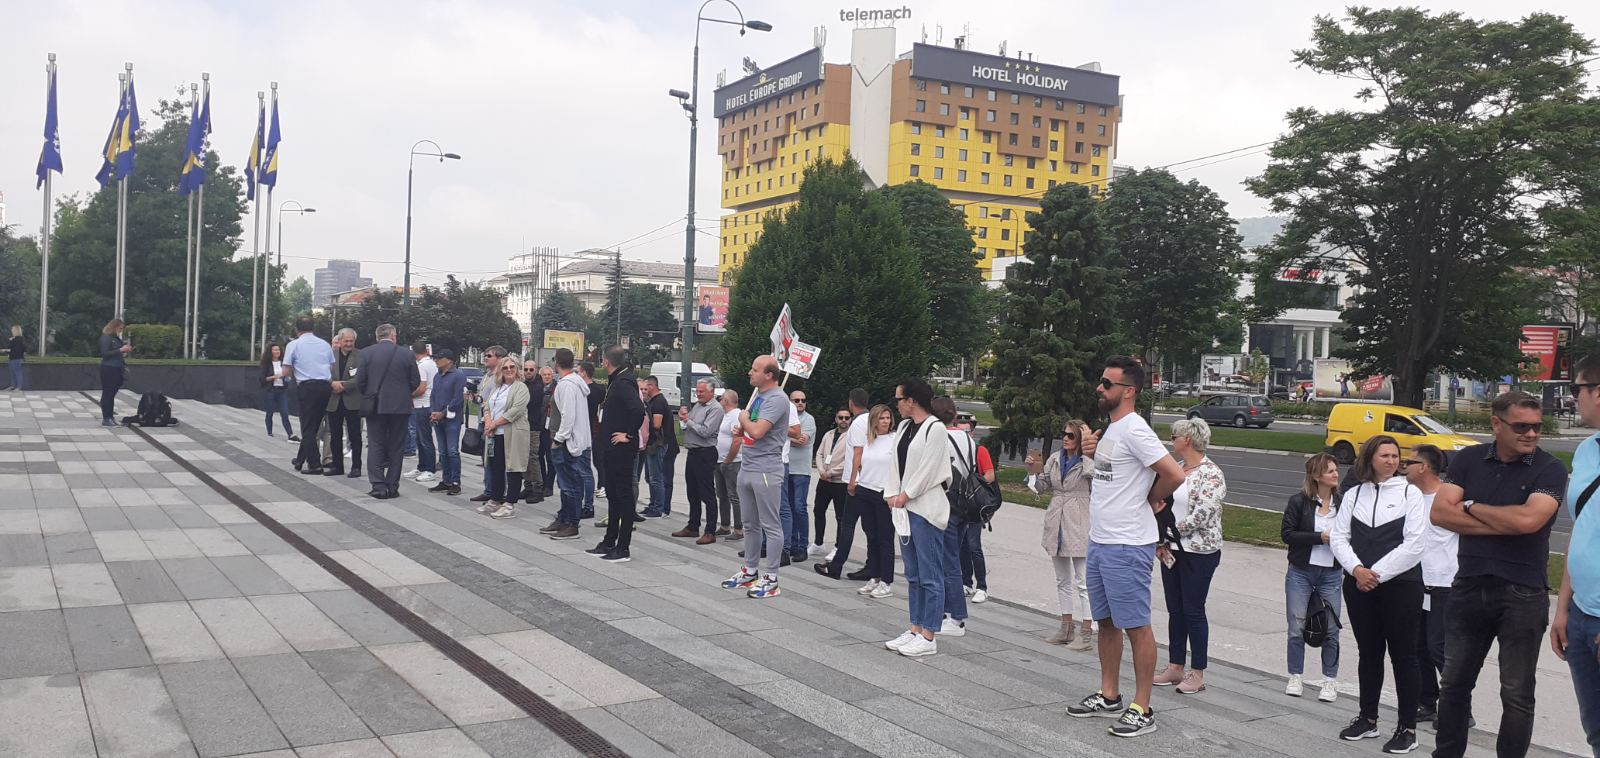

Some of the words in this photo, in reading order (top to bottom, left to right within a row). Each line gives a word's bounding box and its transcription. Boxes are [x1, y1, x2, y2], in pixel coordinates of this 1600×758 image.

[839, 5, 912, 22] telemach
[726, 93, 748, 111] HOTEL
[749, 81, 777, 102] EUROPE
[778, 71, 803, 91] GROUP
[972, 65, 1012, 83] HOTEL
[1016, 72, 1069, 91] HOLIDAY
